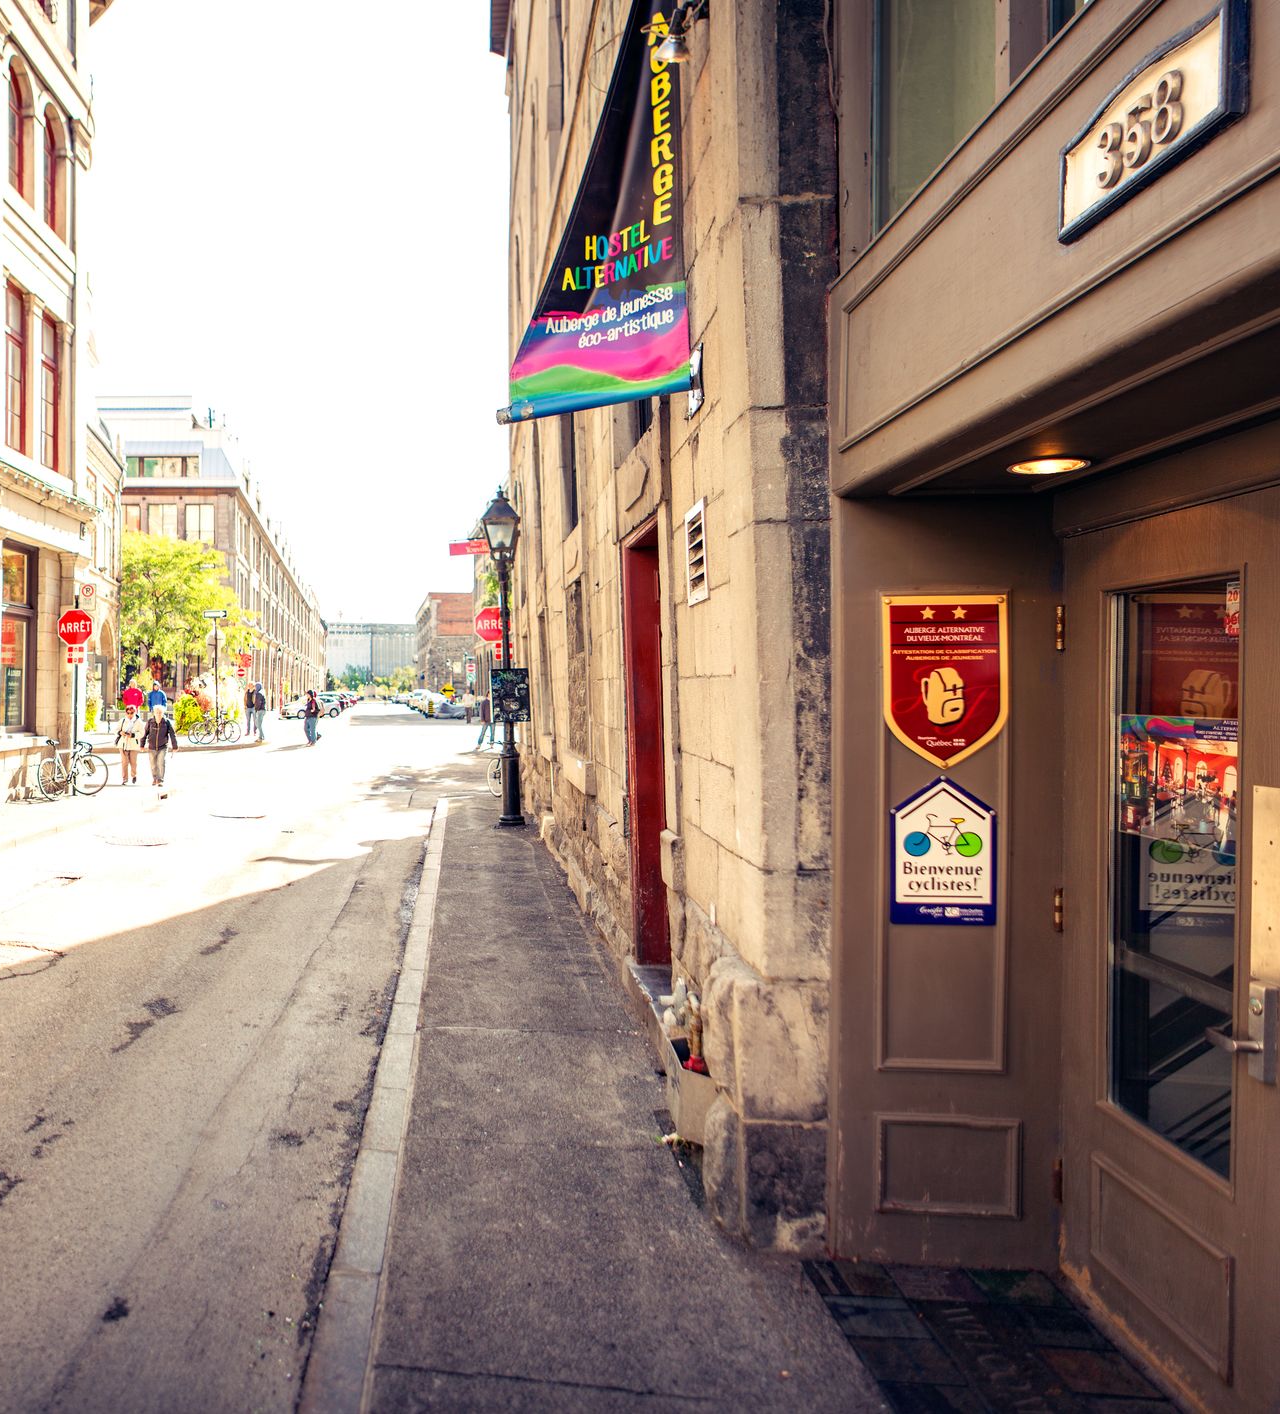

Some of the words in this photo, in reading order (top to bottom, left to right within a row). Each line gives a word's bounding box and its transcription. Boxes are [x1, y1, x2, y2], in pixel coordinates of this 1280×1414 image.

[647, 11, 674, 227] AUBERGE
[1096, 68, 1184, 190] 358
[585, 219, 651, 261] HOSTEL
[561, 236, 673, 291] ALTERNATIVE
[545, 312, 600, 334] Auberge
[602, 306, 617, 324] de
[617, 286, 674, 322] jeunesse
[578, 308, 674, 349] éco-artistique
[60, 620, 91, 633] ARRÊT
[904, 626, 936, 634] AUBERGE
[903, 861, 984, 876] Bienvenue
[908, 877, 977, 893] cyclistes!
